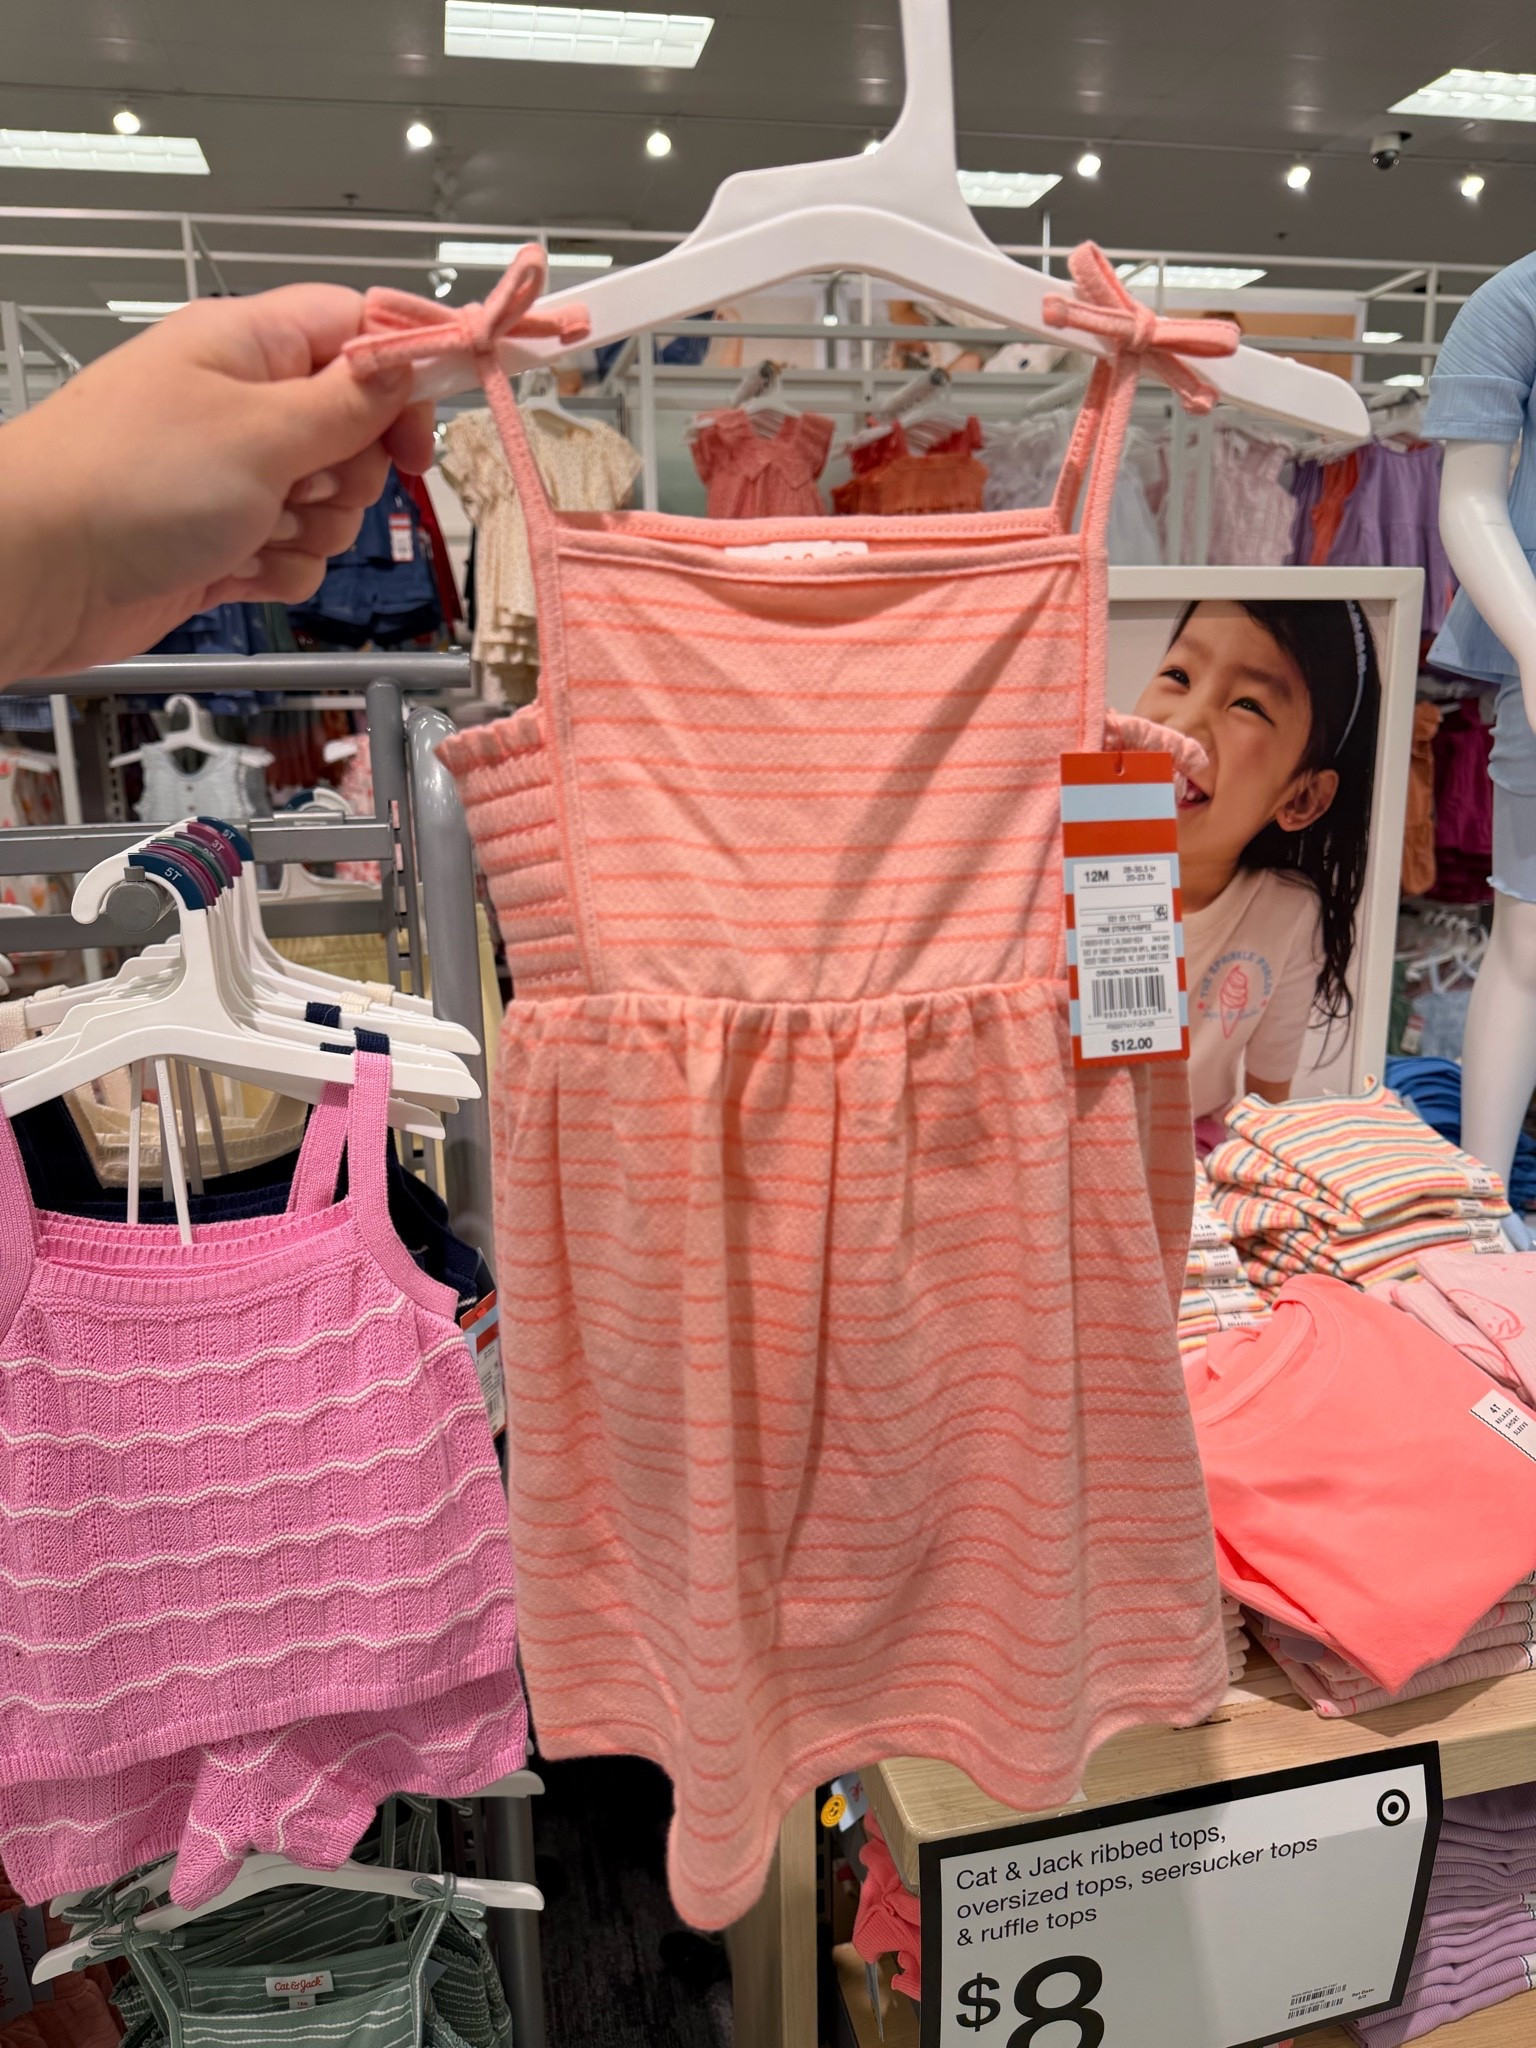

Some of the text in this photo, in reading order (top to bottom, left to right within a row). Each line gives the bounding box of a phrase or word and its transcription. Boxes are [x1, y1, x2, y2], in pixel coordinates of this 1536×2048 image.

[211, 840, 225, 852] 3T
[164, 866, 182, 882] 5T
[1084, 870, 1110, 883] 12M
[1096, 966, 1160, 977] ORIGIN: INDONESIA
[1111, 1037, 1153, 1052] $12.00
[1489, 1403, 1501, 1414] 4T
[1495, 1407, 1514, 1425] RELAXED
[1505, 1415, 1520, 1430] SHORT
[1513, 1421, 1529, 1436] SLEEVE
[956, 1826, 1226, 1890] Cat & Jack ribbed tops,
[957, 1838, 1318, 1919] oversized tops, seersucker tops
[957, 1907, 1097, 1946] & ruffle tops
[274, 1981, 290, 1991] Cat
[291, 1981, 300, 1991] &
[956, 1955, 1105, 2048] $8
